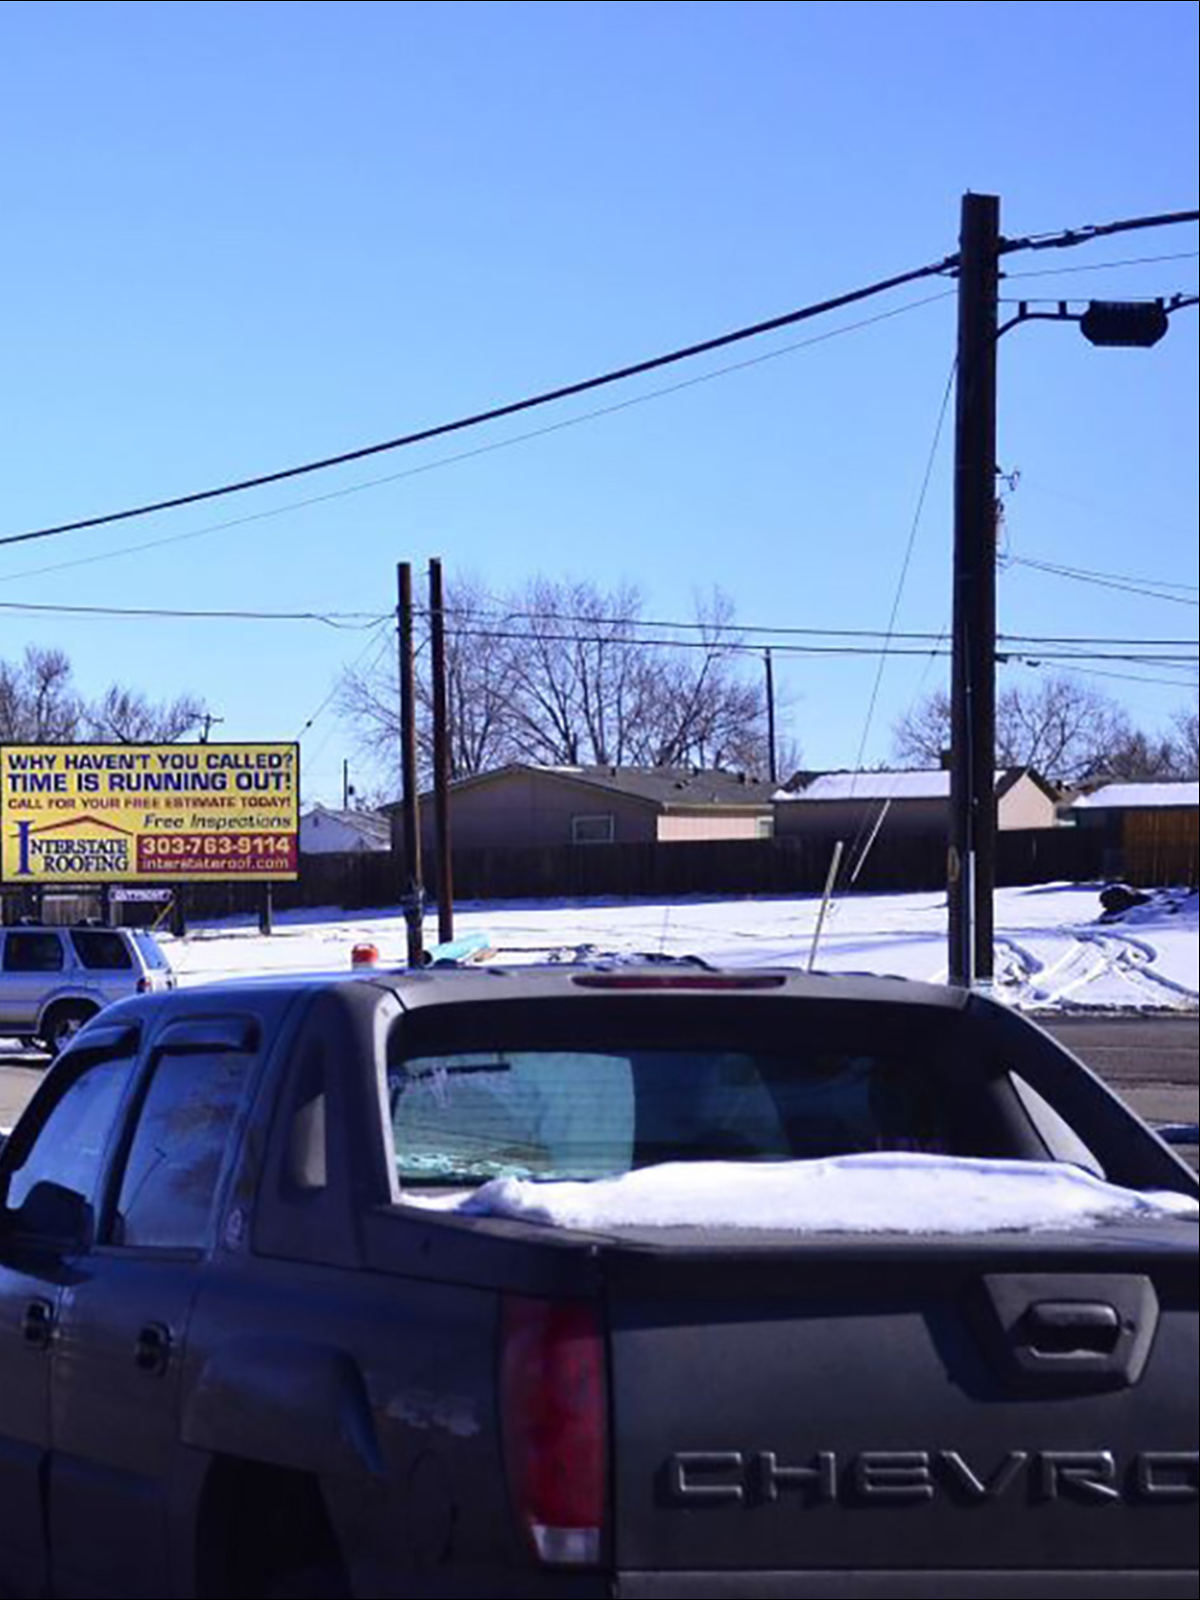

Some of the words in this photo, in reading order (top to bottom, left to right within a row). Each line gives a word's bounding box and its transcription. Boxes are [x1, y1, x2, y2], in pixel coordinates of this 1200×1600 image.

[8, 754, 57, 770] WHY
[64, 753, 151, 770] HAVEN'T
[158, 753, 199, 770] YOU
[206, 753, 293, 770] CALLED?
[7, 773, 67, 792] TIME
[76, 773, 99, 791] IS
[108, 772, 227, 791] RUNNING
[235, 772, 292, 791] OUT!
[7, 798, 43, 809] CALL
[47, 798, 76, 809] FOR
[80, 798, 120, 809] YOUR
[123, 798, 161, 808] FREE
[165, 797, 237, 808] ESTIMATE
[240, 797, 292, 808] TODAY!
[143, 814, 185, 828] Free
[190, 814, 291, 830] Inspections
[12, 820, 129, 876] INTERSTATE
[141, 836, 291, 855] 303-763-9114
[43, 856, 129, 873] ROOFING
[142, 856, 289, 870] interstateroof.com
